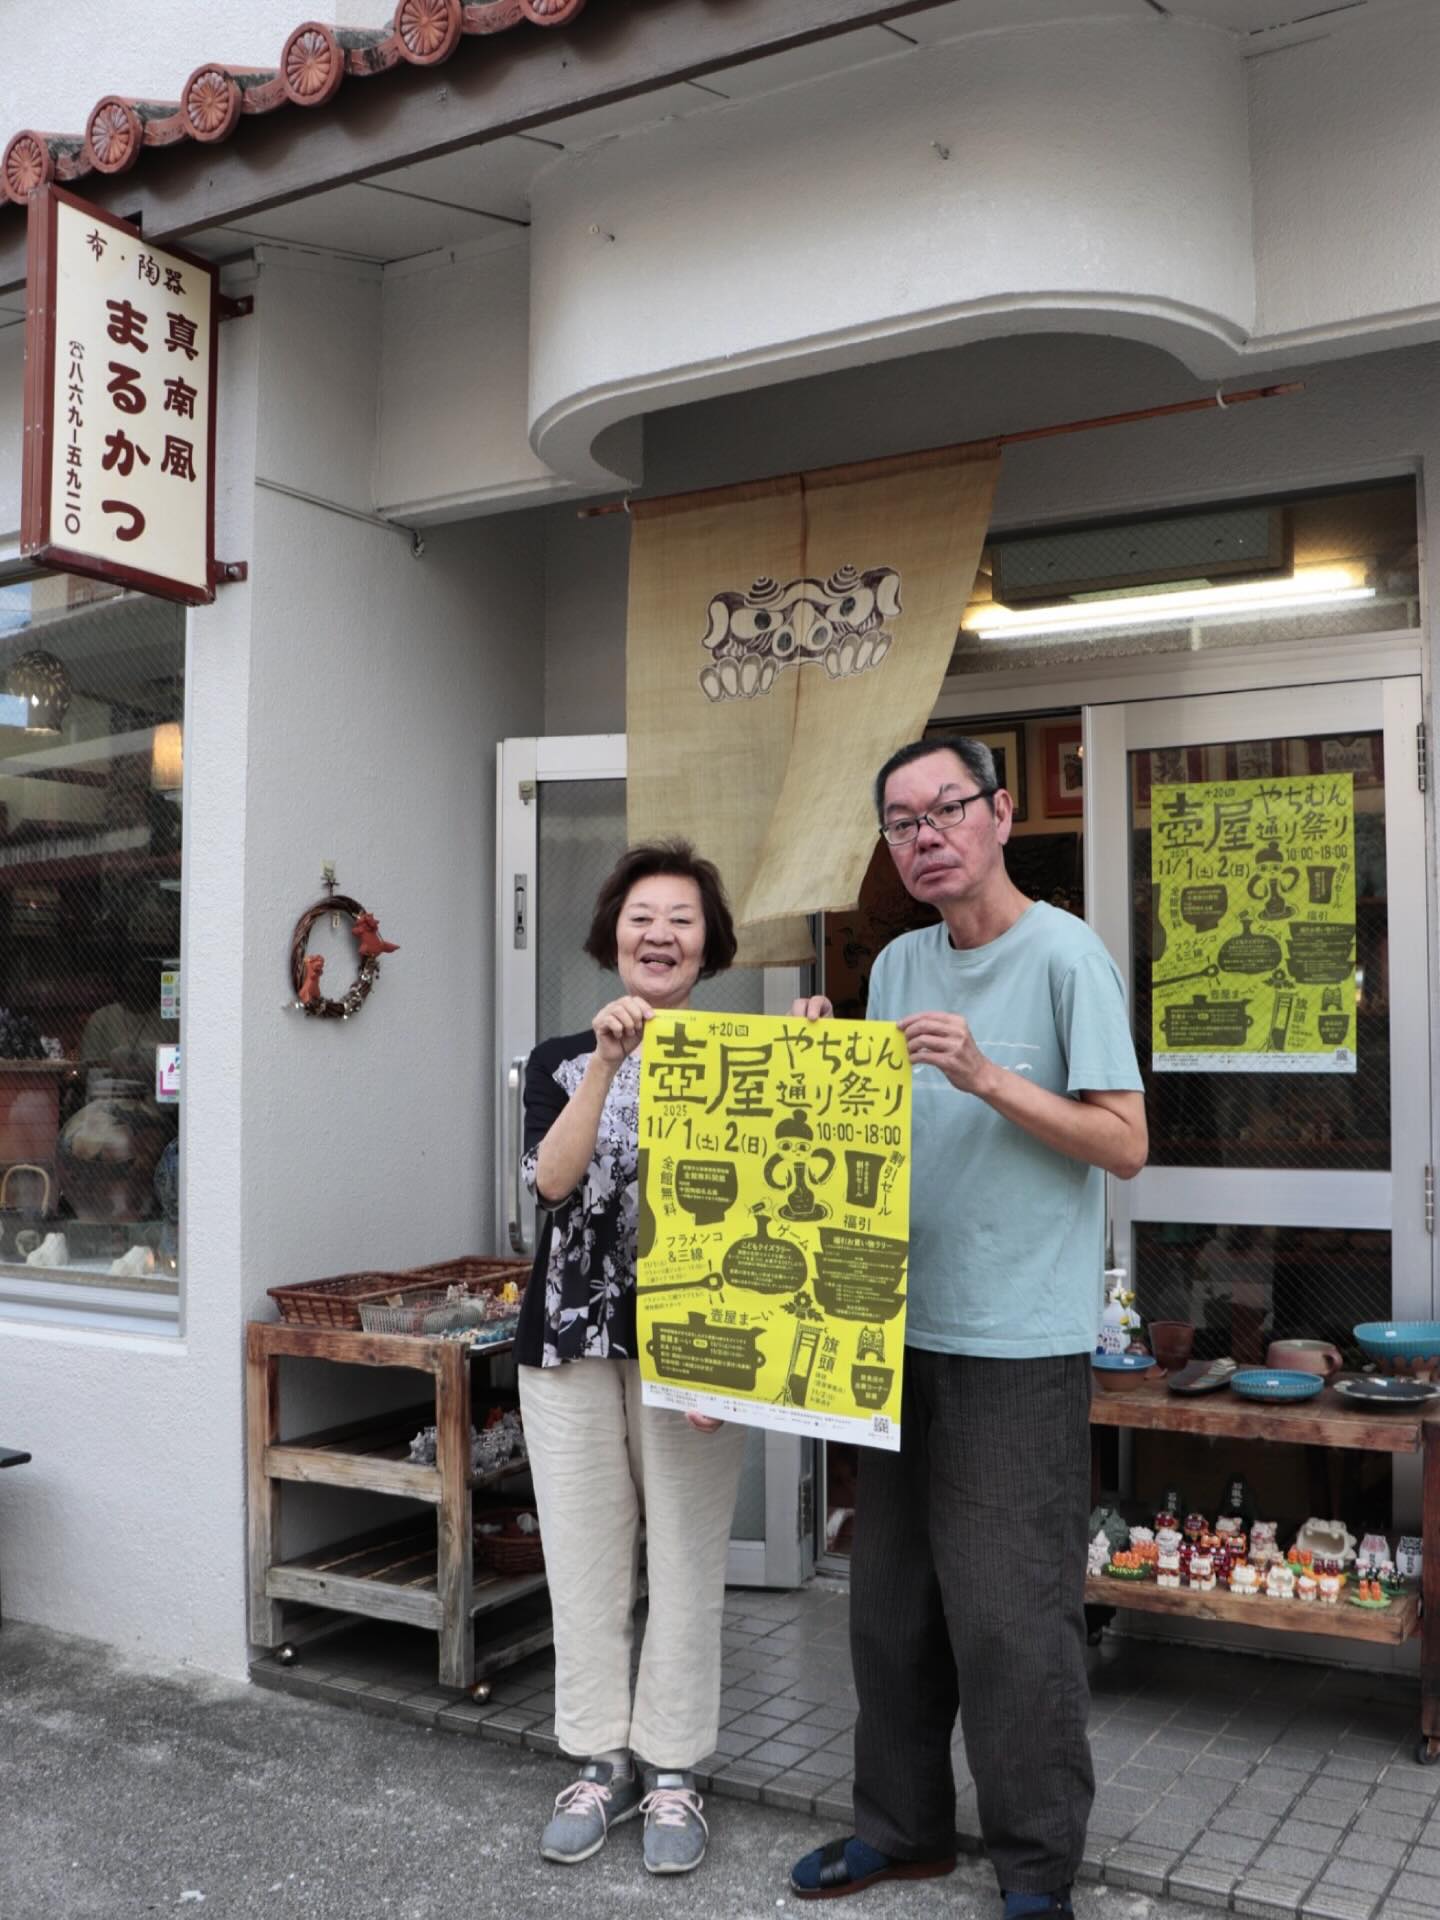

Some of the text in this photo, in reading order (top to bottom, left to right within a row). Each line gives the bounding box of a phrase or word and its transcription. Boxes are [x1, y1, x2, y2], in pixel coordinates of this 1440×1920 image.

[160, 312, 199, 482] 真南風
[101, 299, 151, 542] まるかつ
[1253, 784, 1347, 814] やちむん
[1256, 811, 1348, 844] 通り祭り
[773, 1024, 904, 1075] やちむん
[663, 1104, 688, 1117] 2025
[776, 1070, 904, 1117] 通り祭り
[666, 1231, 723, 1248] フラメンコ
